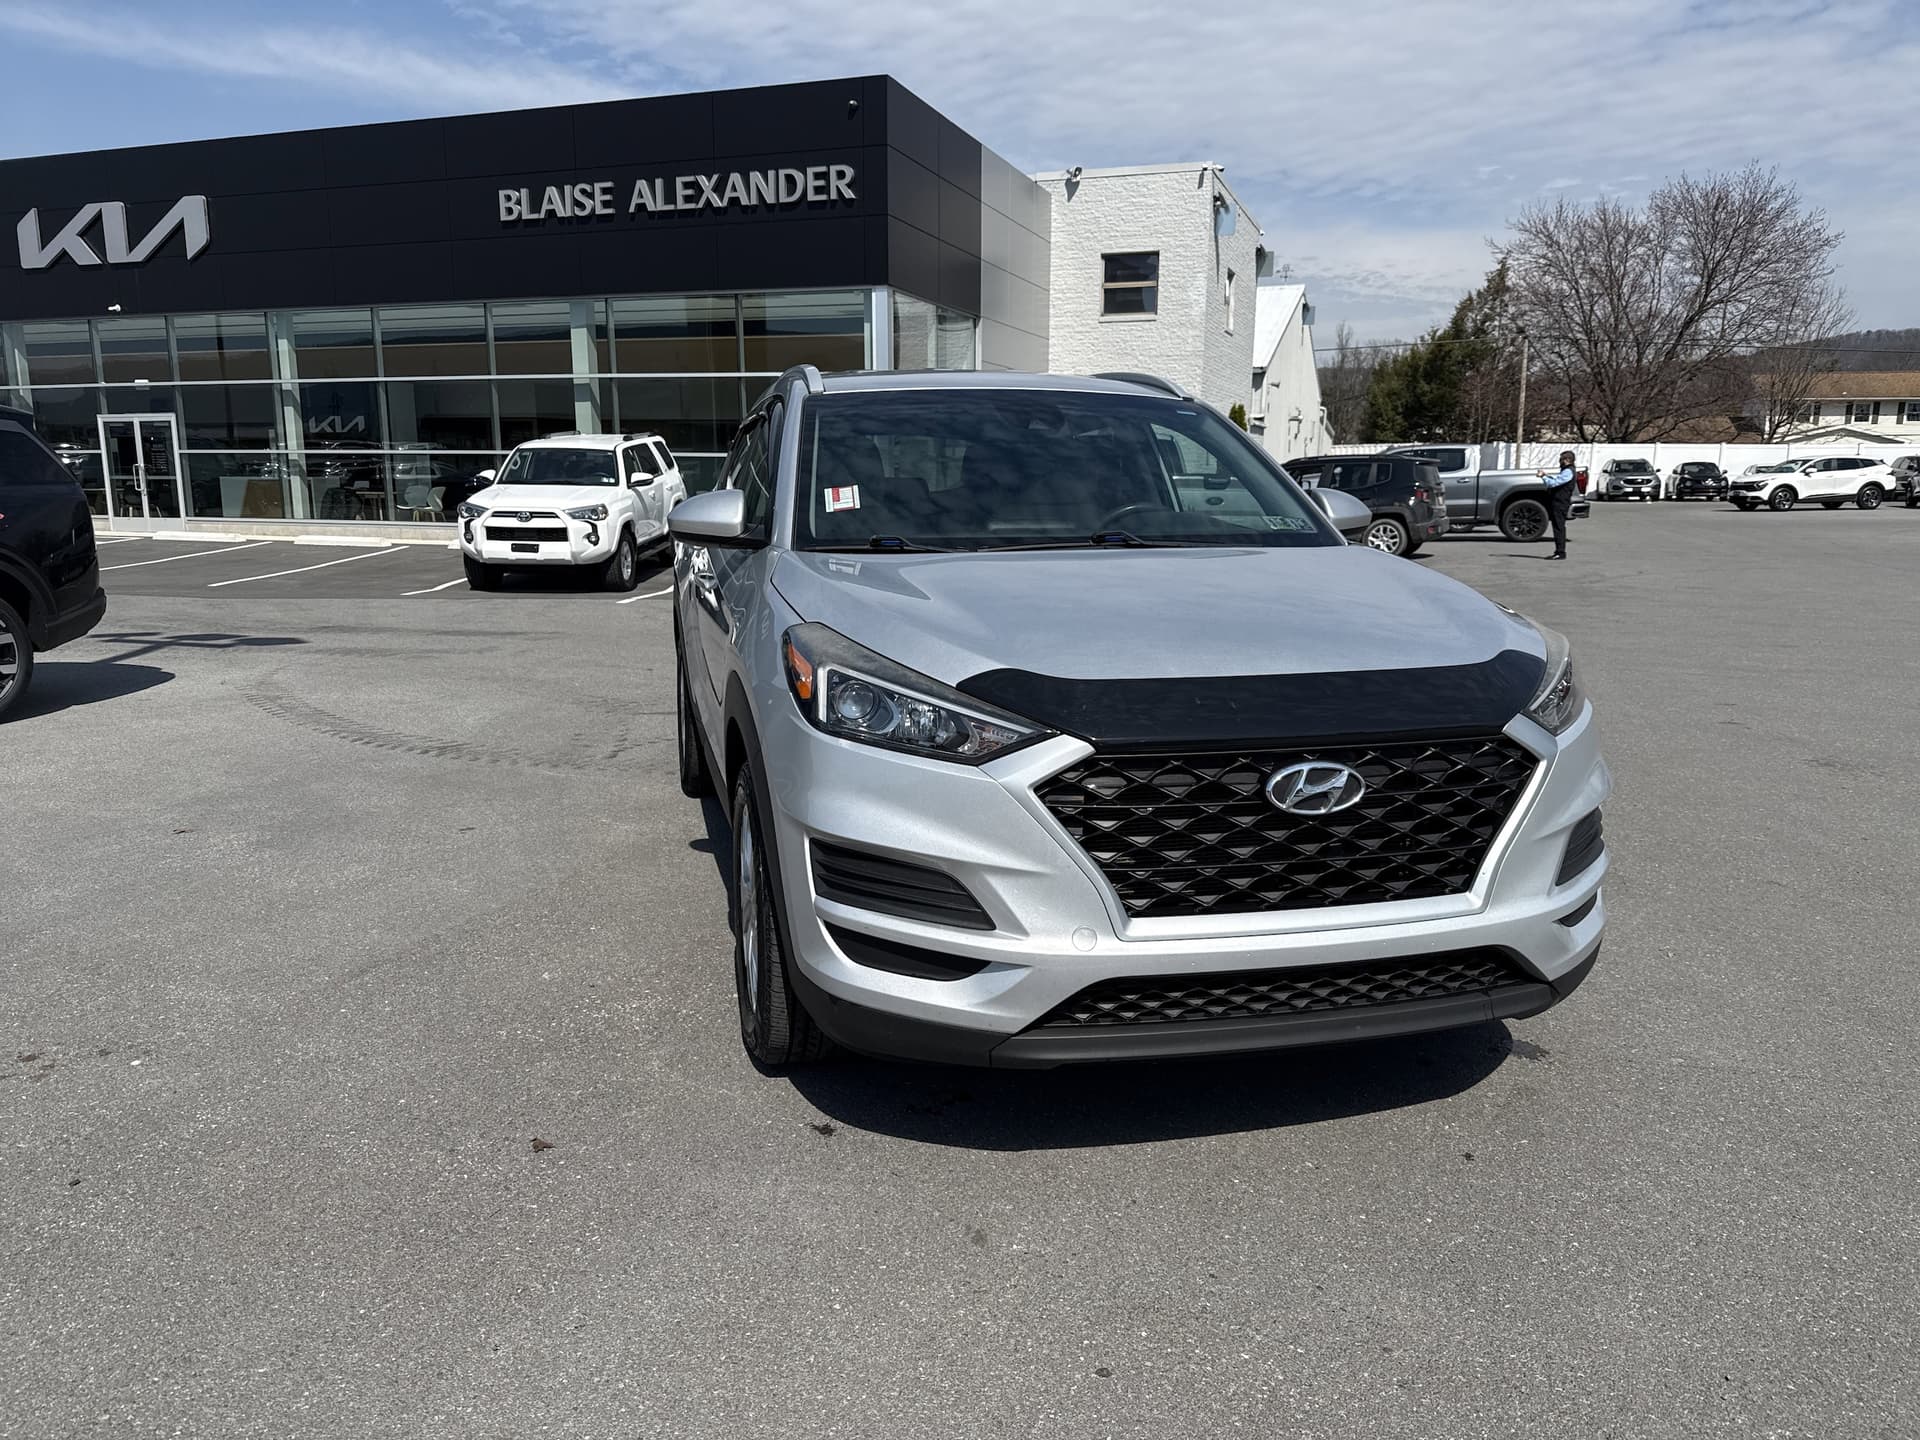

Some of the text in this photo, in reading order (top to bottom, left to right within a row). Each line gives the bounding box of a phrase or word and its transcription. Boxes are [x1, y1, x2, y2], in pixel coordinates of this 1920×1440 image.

[498, 164, 856, 221] BLAISE ALEXANDER
[17, 195, 210, 269] KIA
[309, 415, 365, 433] KIA
